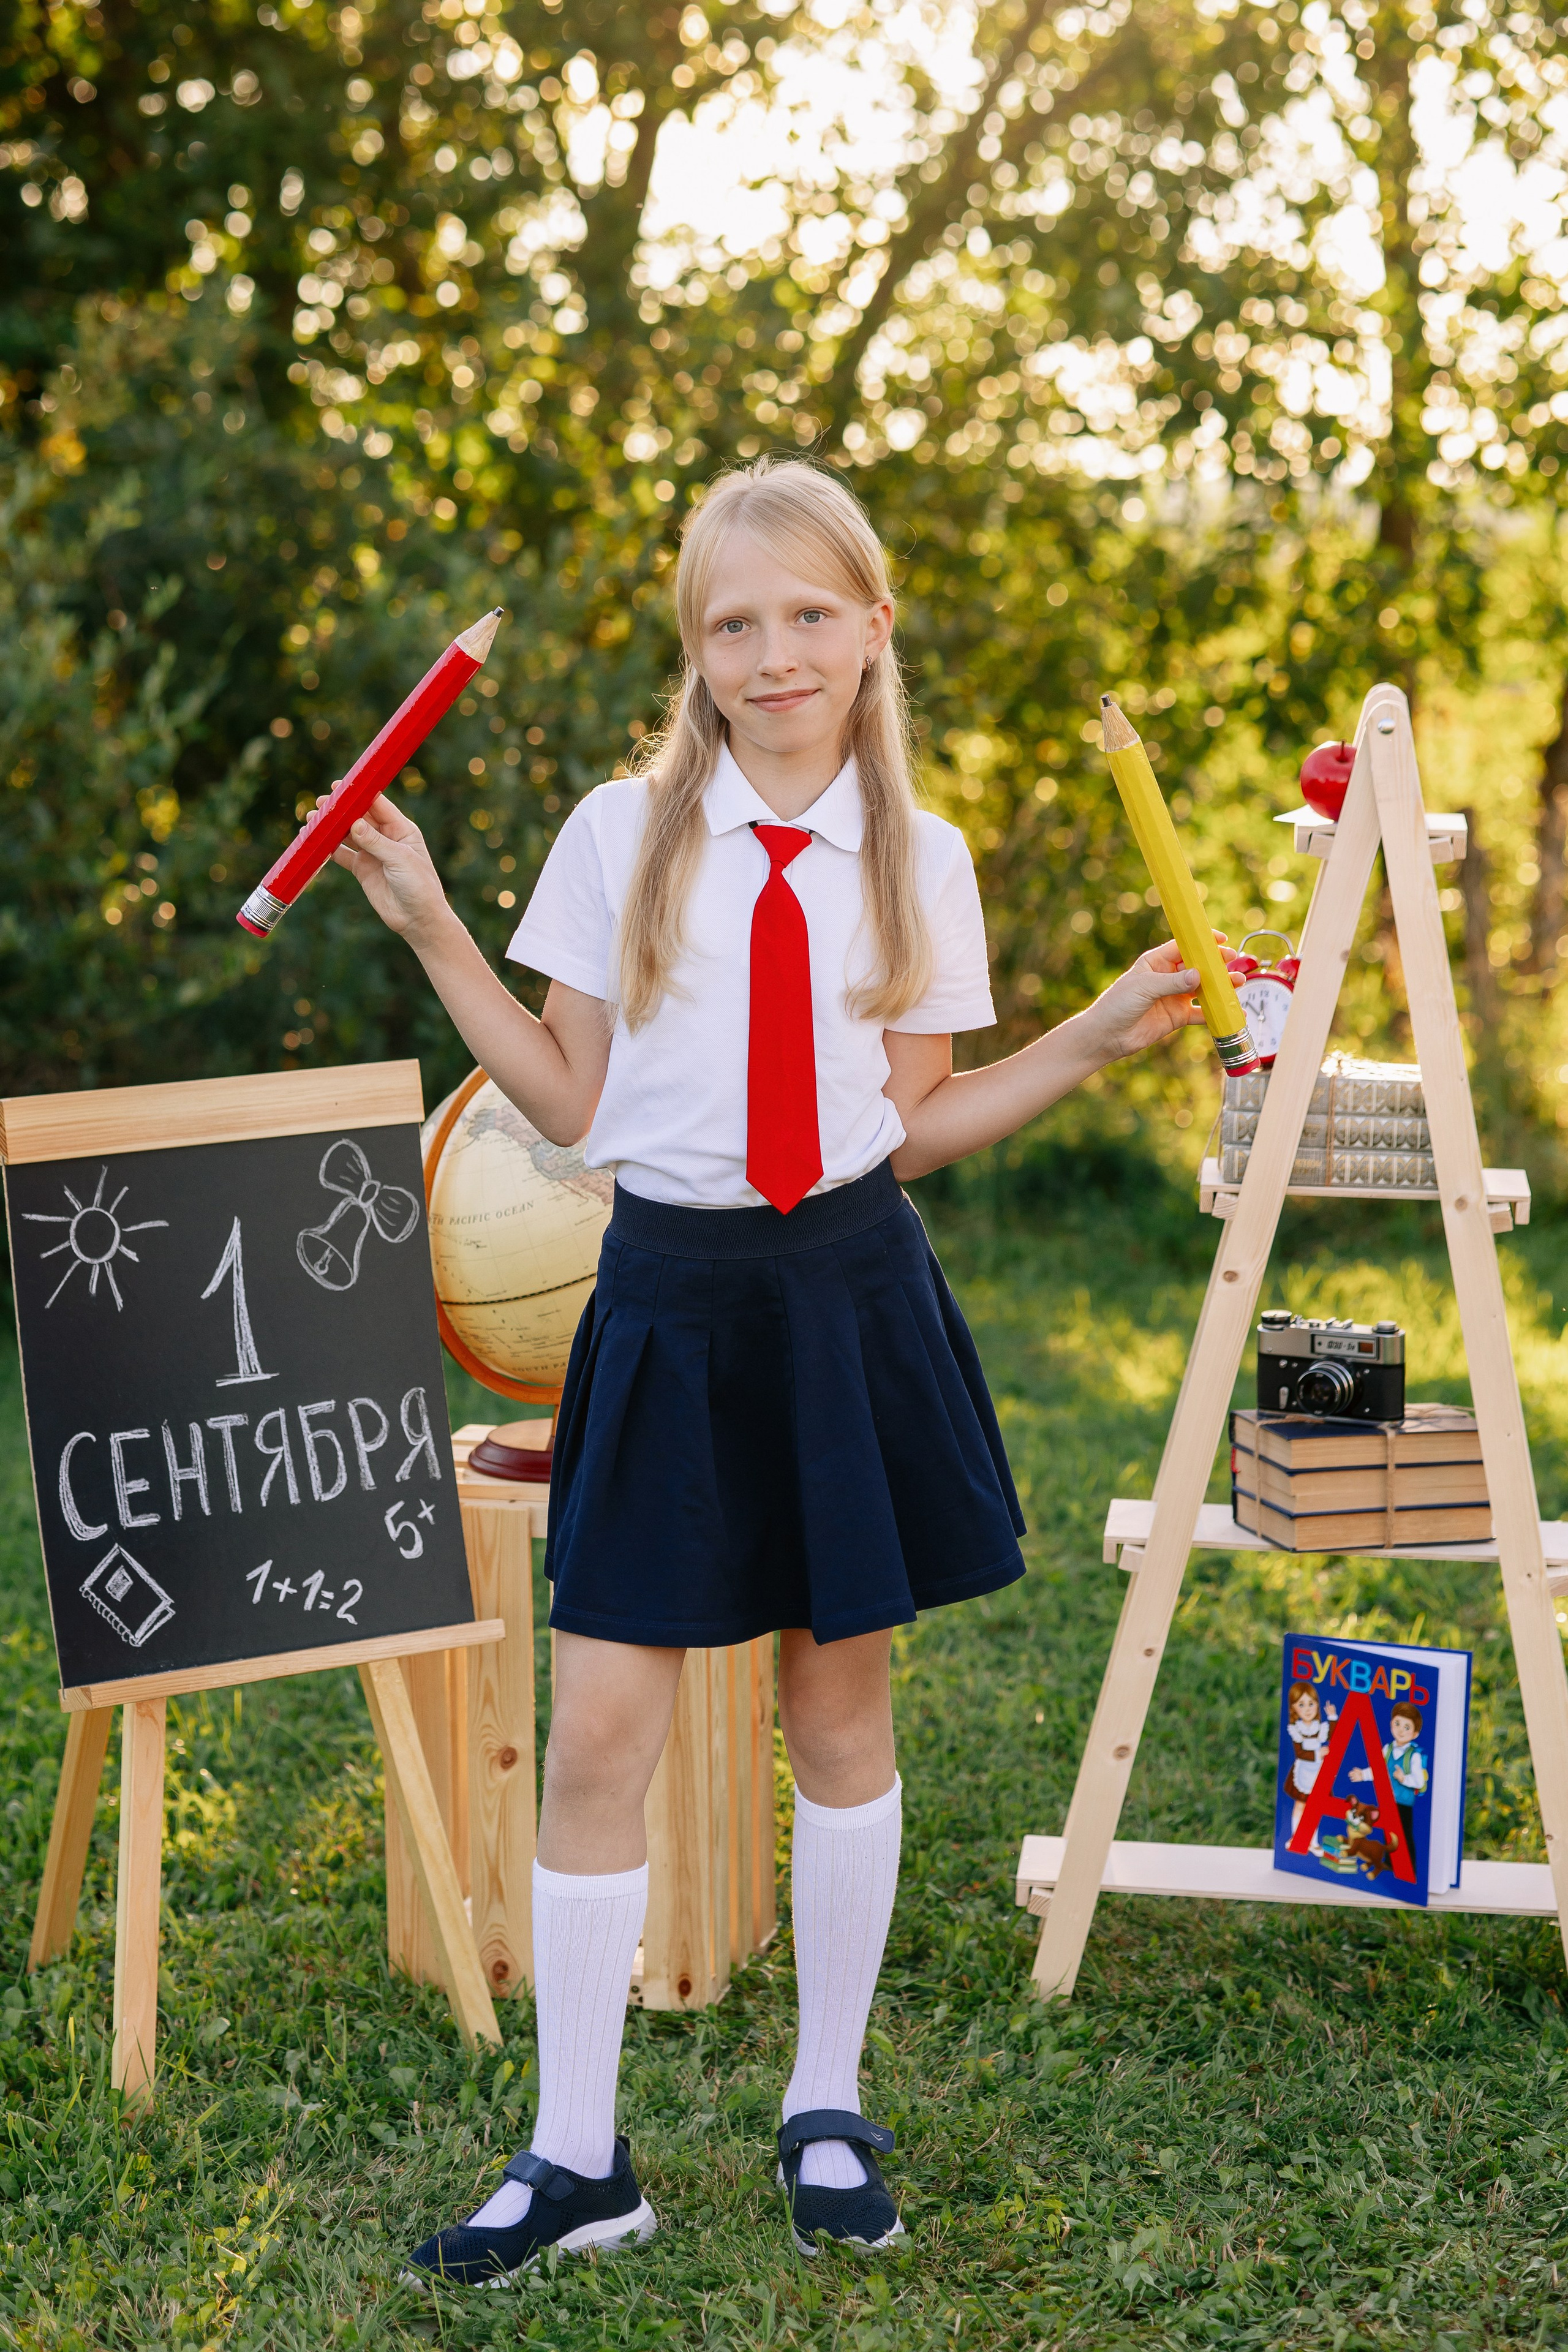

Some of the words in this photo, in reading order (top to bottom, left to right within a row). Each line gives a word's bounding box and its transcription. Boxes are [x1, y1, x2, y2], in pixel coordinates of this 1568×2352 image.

[449, 1212, 491, 1226] PACIFIC
[496, 1200, 535, 1220] OCEAN
[200, 1216, 280, 1387] 1
[59, 1387, 442, 1541] СЕНТЯБРЯ
[384, 1499, 435, 1559] 5+
[246, 1559, 363, 1626] 1+1=2
[1292, 1648, 1430, 1706] БУКВАРЬ
